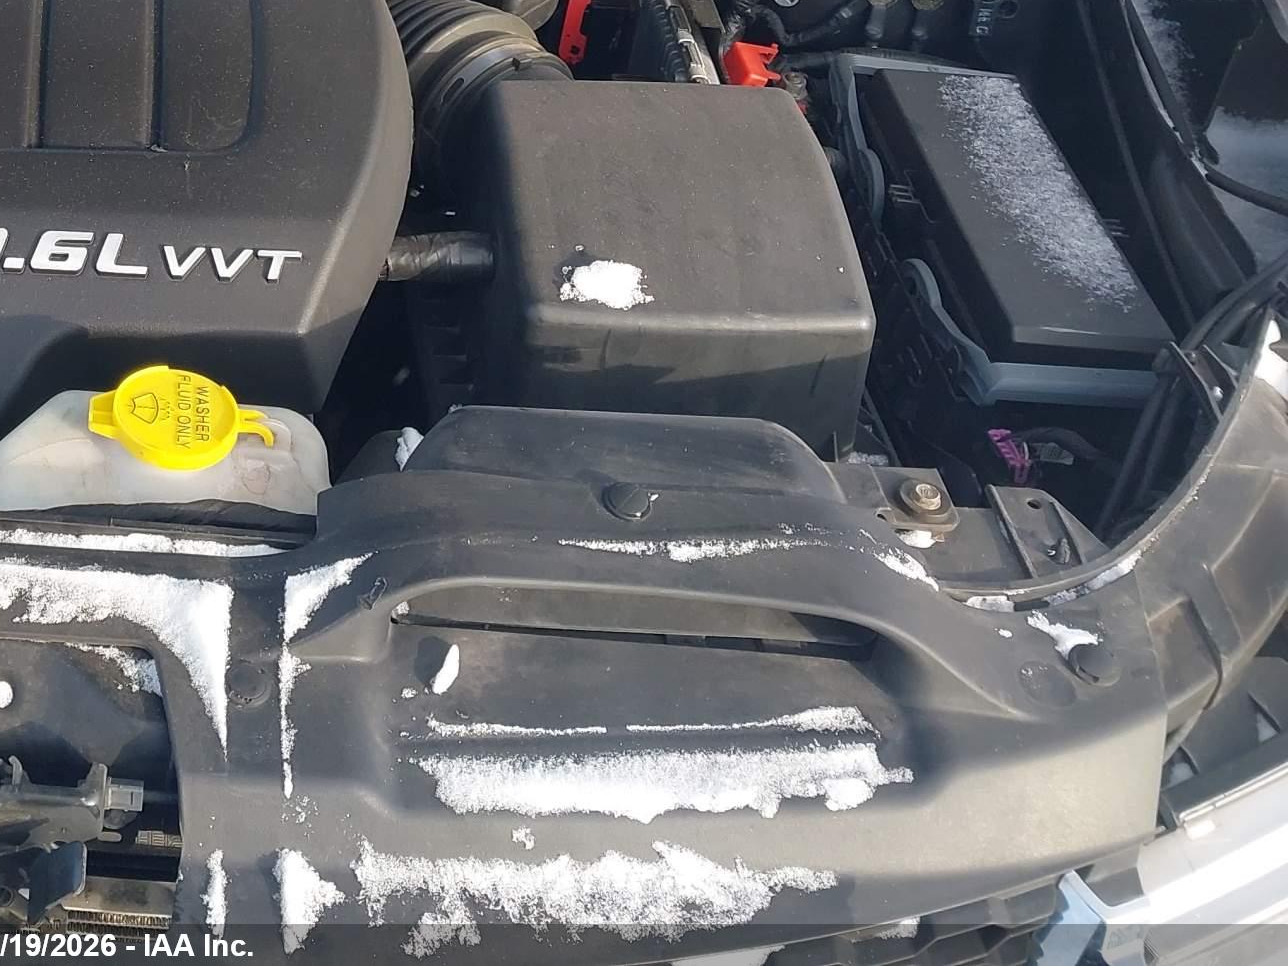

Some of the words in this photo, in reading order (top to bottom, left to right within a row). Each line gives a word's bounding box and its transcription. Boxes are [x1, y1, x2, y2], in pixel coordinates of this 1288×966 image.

[160, 244, 303, 283] VVT
[177, 375, 192, 411] FLUID
[176, 415, 192, 449] ONLY
[195, 386, 210, 442] WASHER
